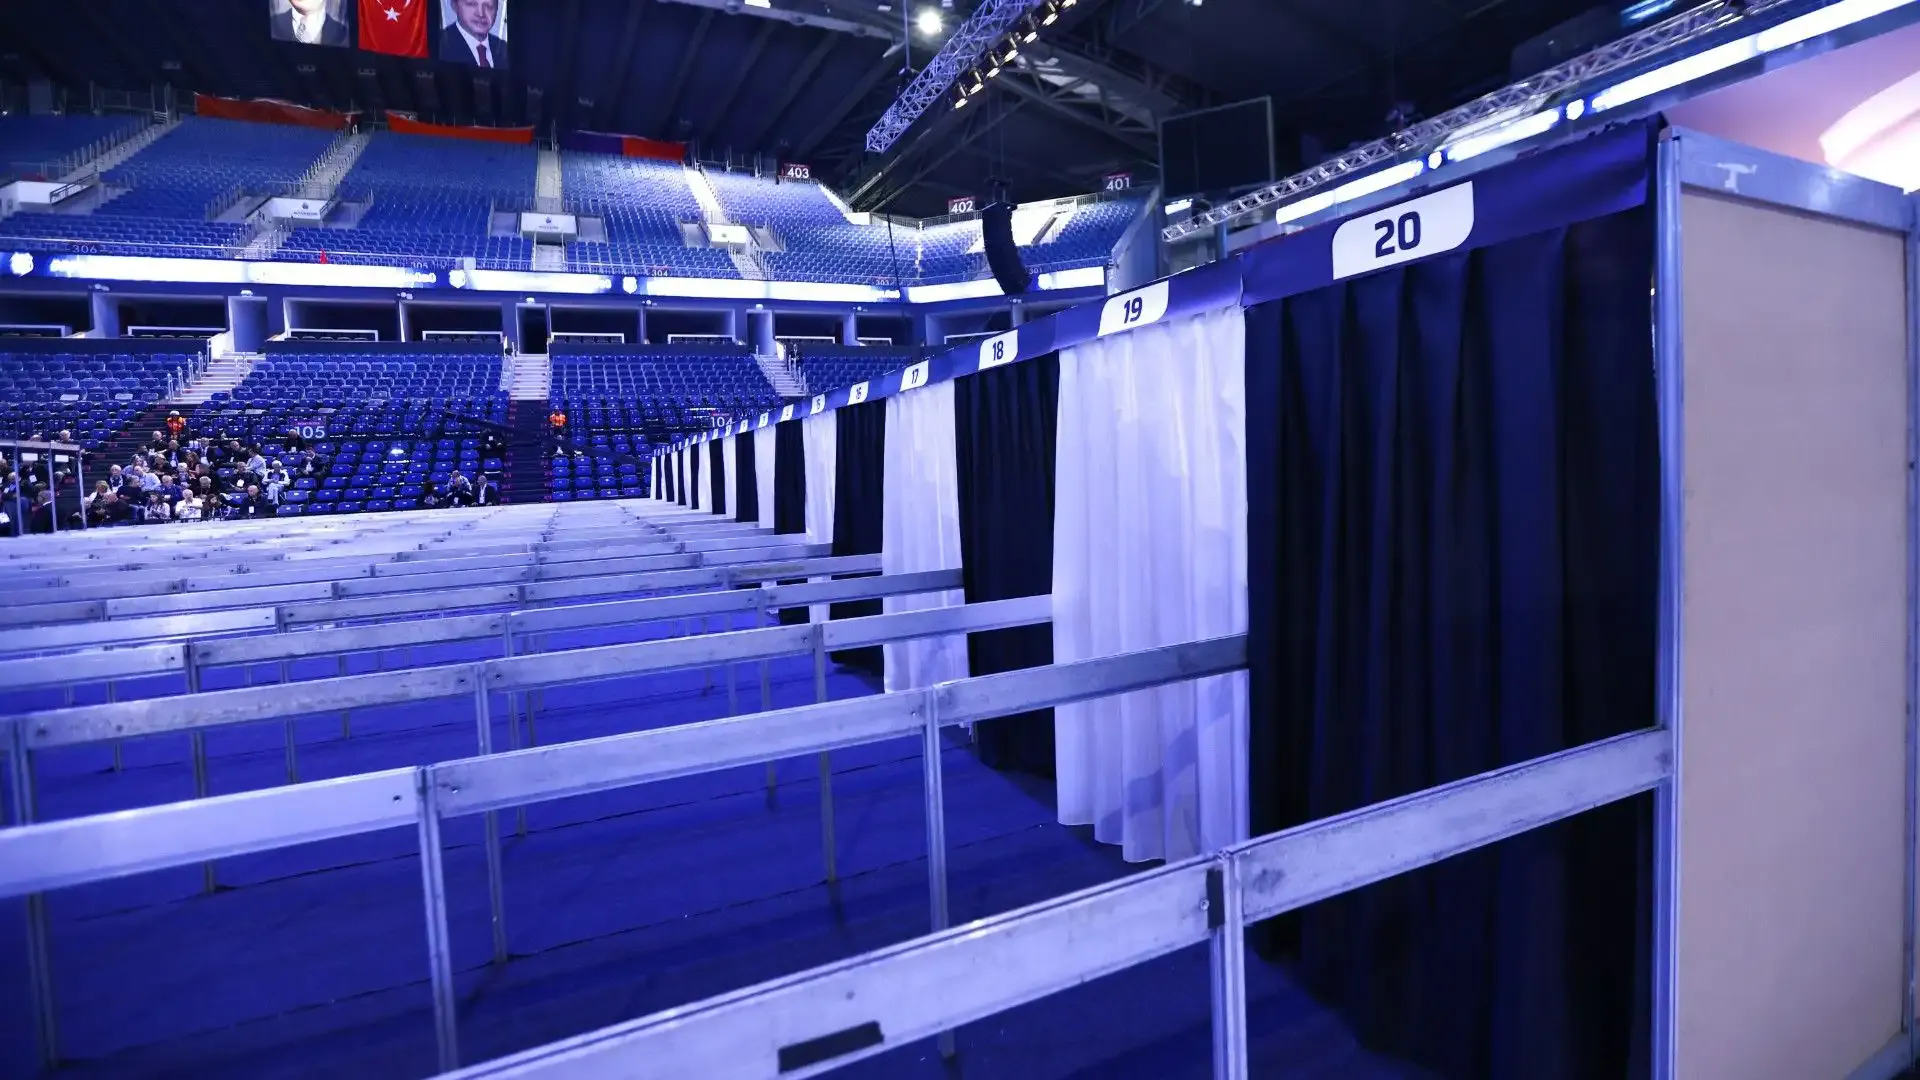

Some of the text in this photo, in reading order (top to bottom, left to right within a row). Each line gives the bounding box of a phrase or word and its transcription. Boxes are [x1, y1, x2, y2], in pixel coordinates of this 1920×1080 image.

[787, 167, 809, 179] 403
[1106, 177, 1130, 191] 401
[951, 200, 974, 213] 402
[1374, 211, 1421, 259] 20
[1124, 296, 1143, 324] 19
[992, 340, 1004, 361] 18
[911, 368, 920, 385] 17
[294, 425, 325, 439] 105
